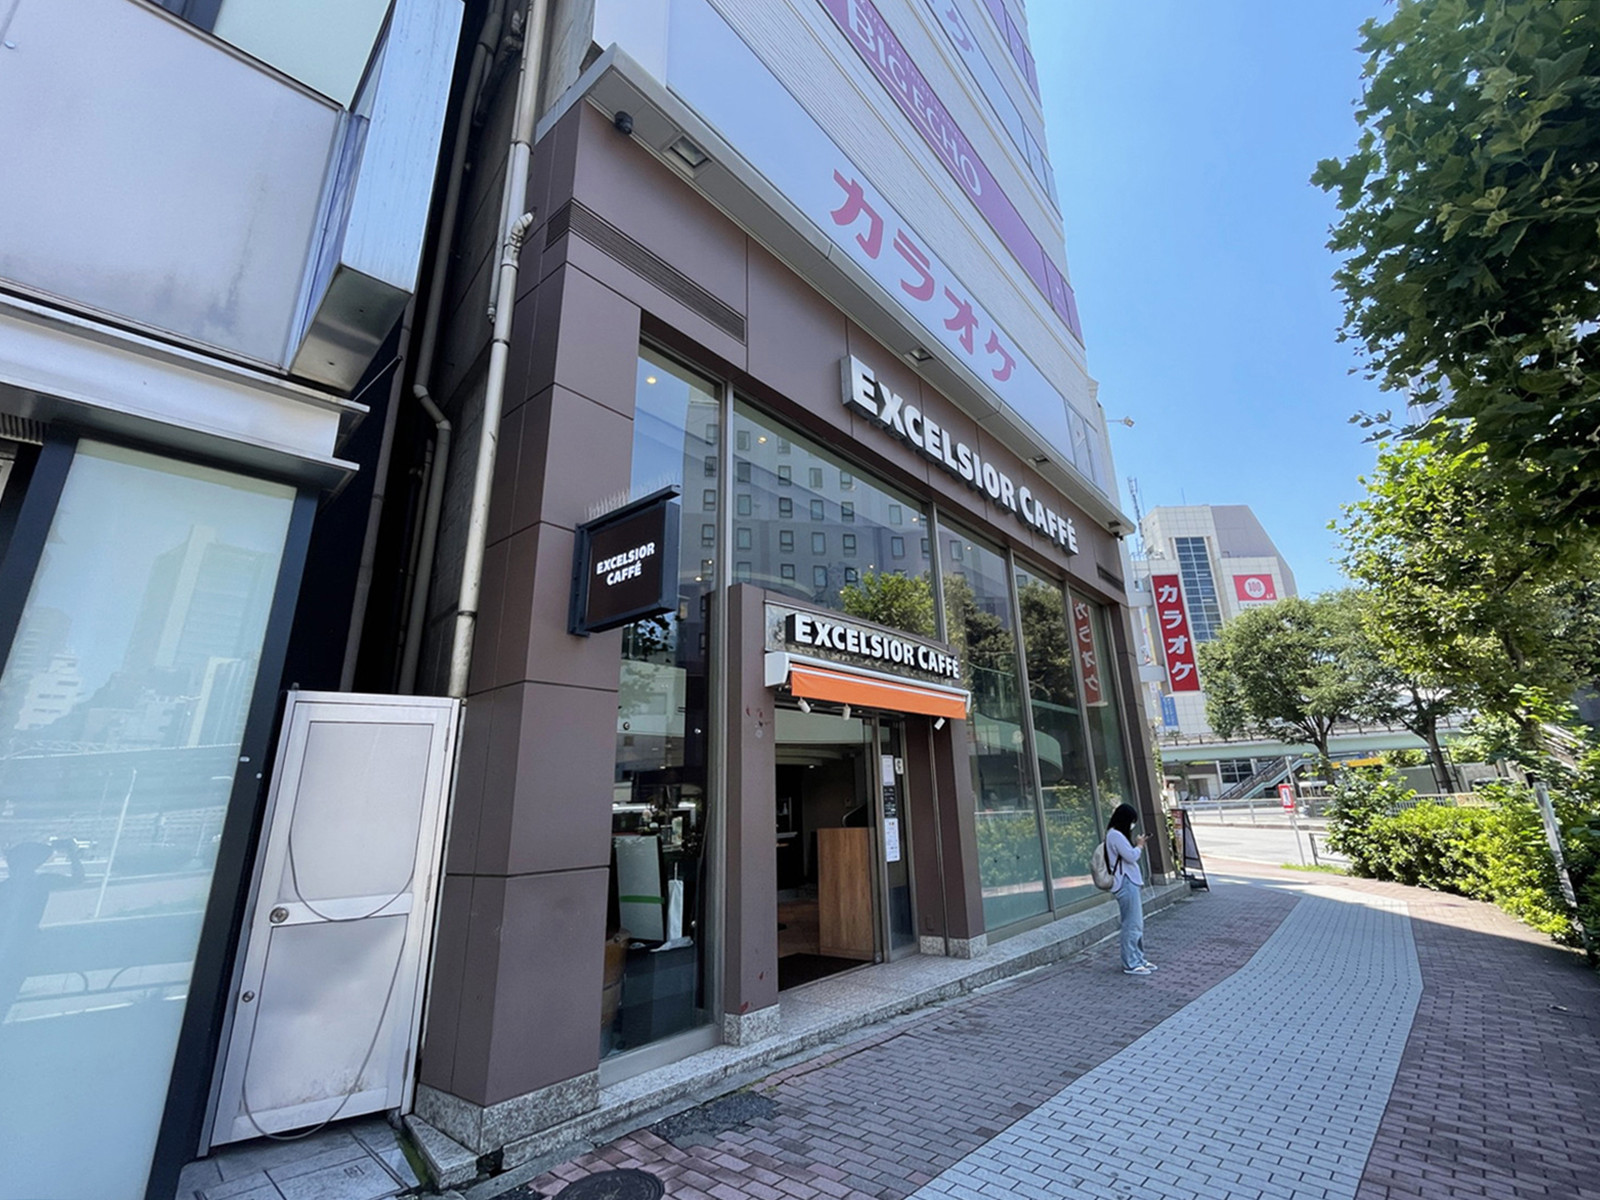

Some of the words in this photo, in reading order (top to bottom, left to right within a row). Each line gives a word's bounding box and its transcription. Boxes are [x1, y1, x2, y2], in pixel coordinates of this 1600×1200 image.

[847, 0, 908, 93] BIG
[912, 87, 982, 197] ECHO
[830, 168, 1017, 383] カラオケ
[849, 354, 1018, 513] EXCELSIOR
[1018, 485, 1079, 555] CAFFÉ
[596, 542, 655, 575] EXCELSIOR
[606, 560, 642, 586] CAFFÉ
[794, 613, 915, 667] EXCELSIOR
[917, 644, 960, 679] CAFFÉ
[1158, 584, 1194, 682] カラオケ
